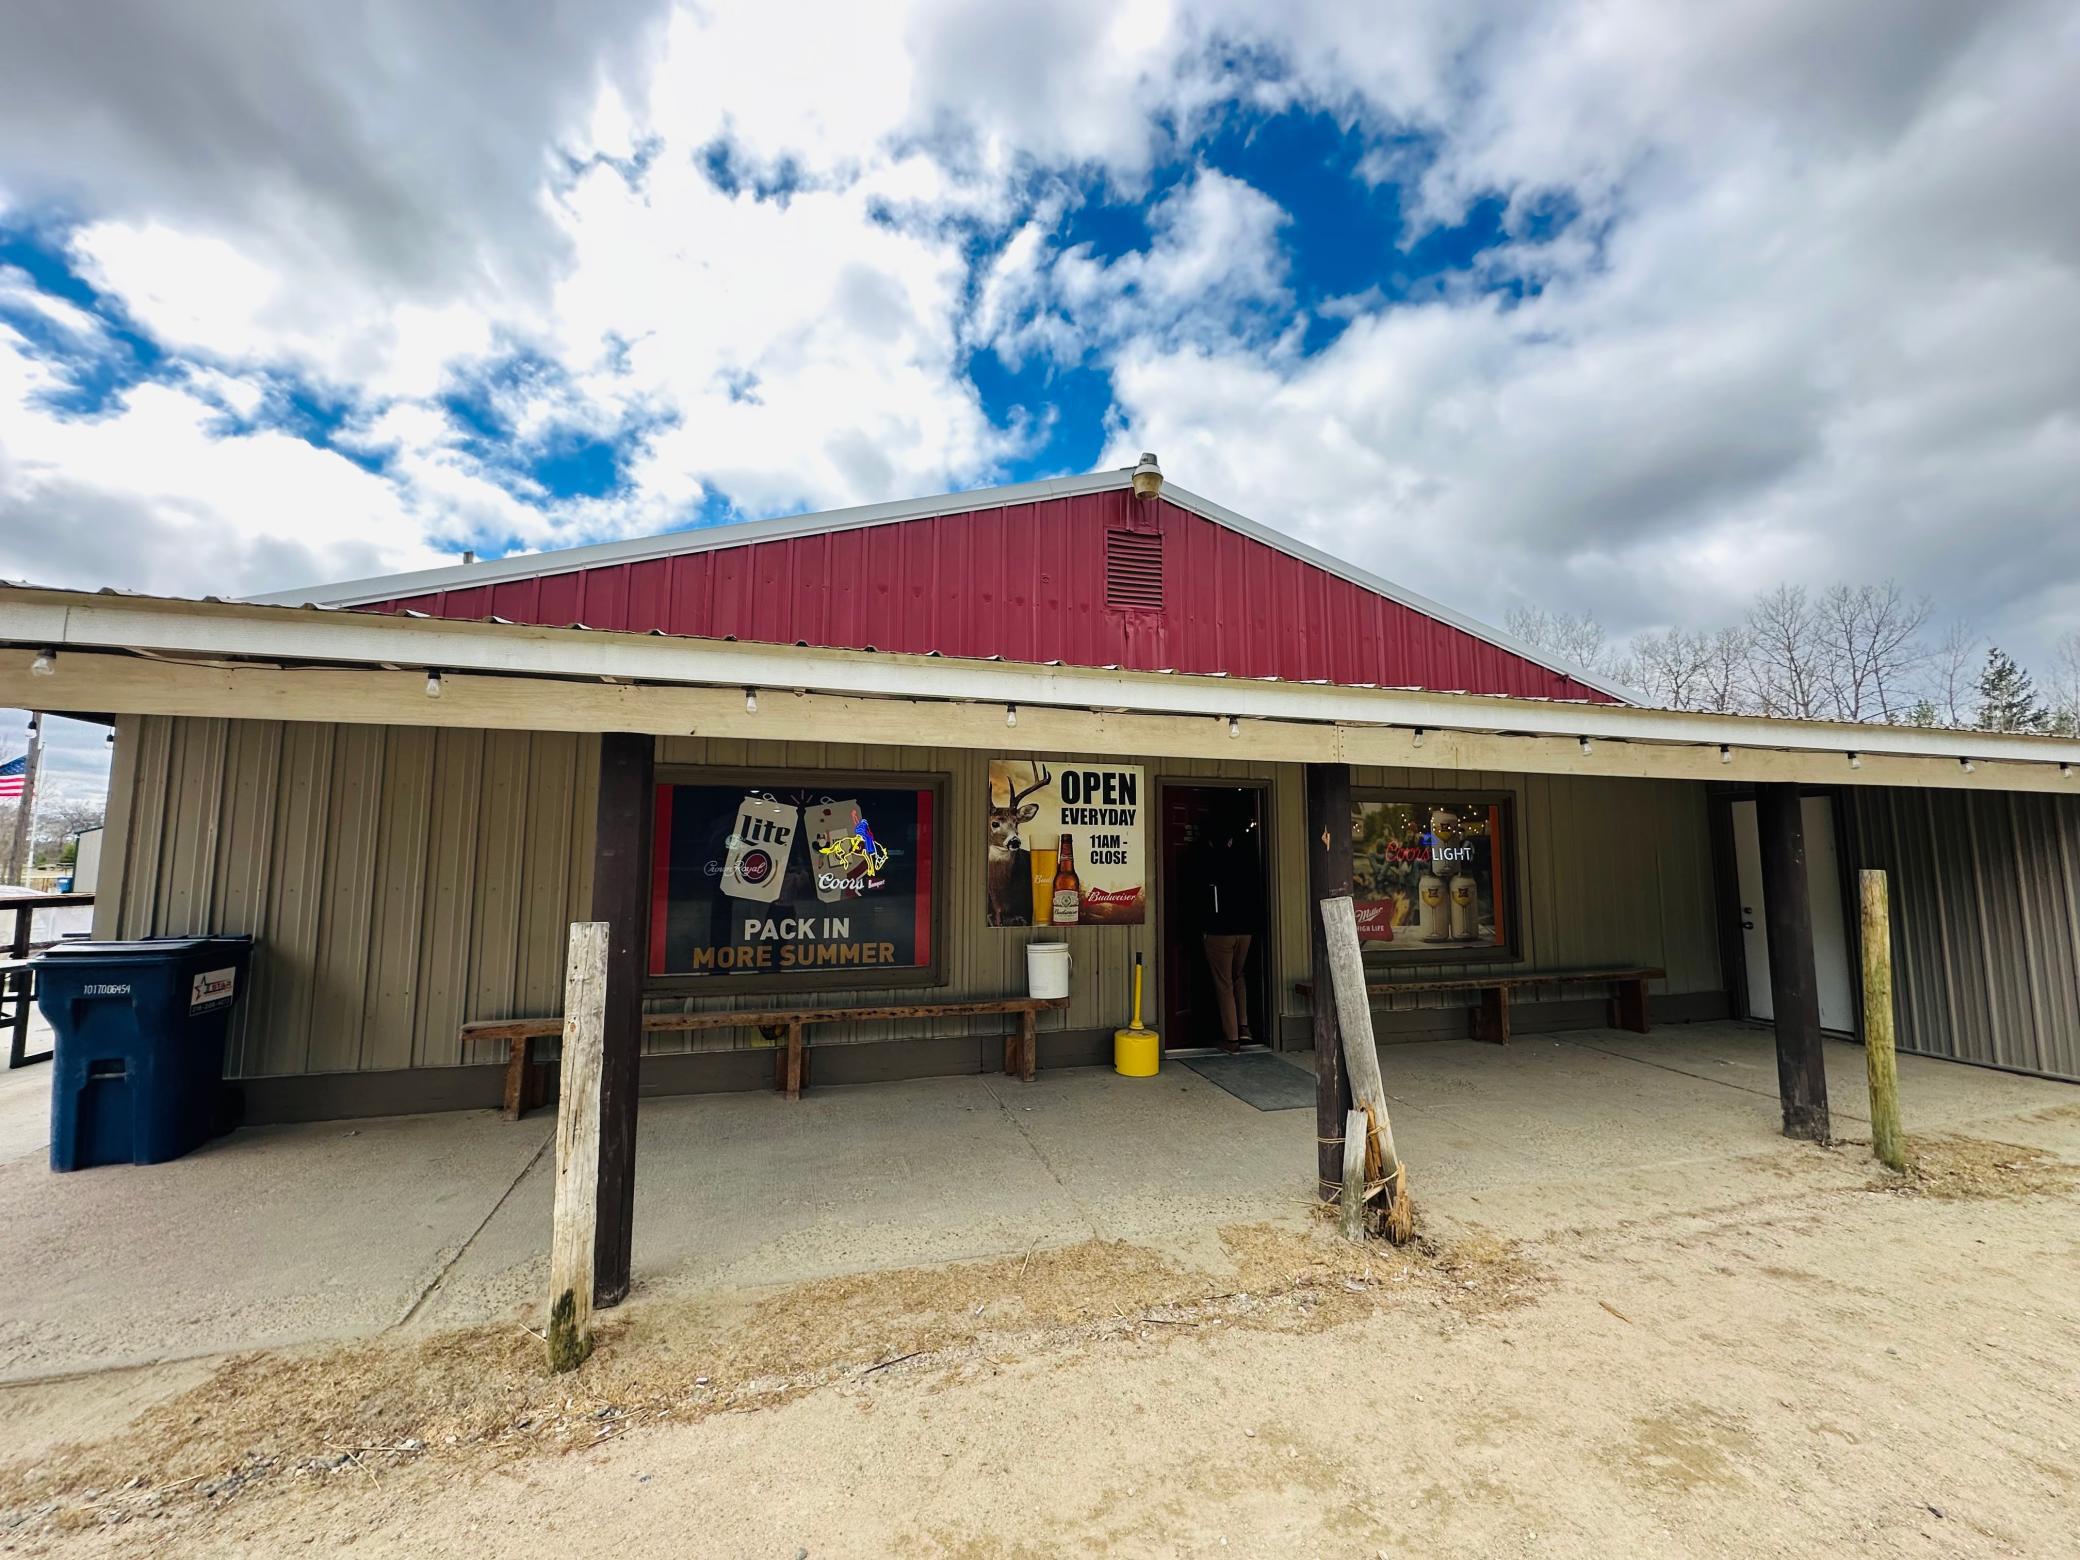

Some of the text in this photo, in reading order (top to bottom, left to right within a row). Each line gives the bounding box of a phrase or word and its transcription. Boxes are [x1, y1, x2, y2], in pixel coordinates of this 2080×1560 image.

[1061, 771, 1137, 806] OPEN
[1061, 808, 1137, 826] EVERYDAY
[741, 814, 791, 847] Lite
[1090, 835, 1120, 849] 11AM
[1090, 851, 1127, 865] CLOSE
[1432, 847, 1472, 861] LIGHT
[818, 872, 865, 890] Coors
[1088, 891, 1136, 902] Budweiser
[744, 917, 850, 941] PACK IN
[692, 942, 895, 969] MORE SUMMER
